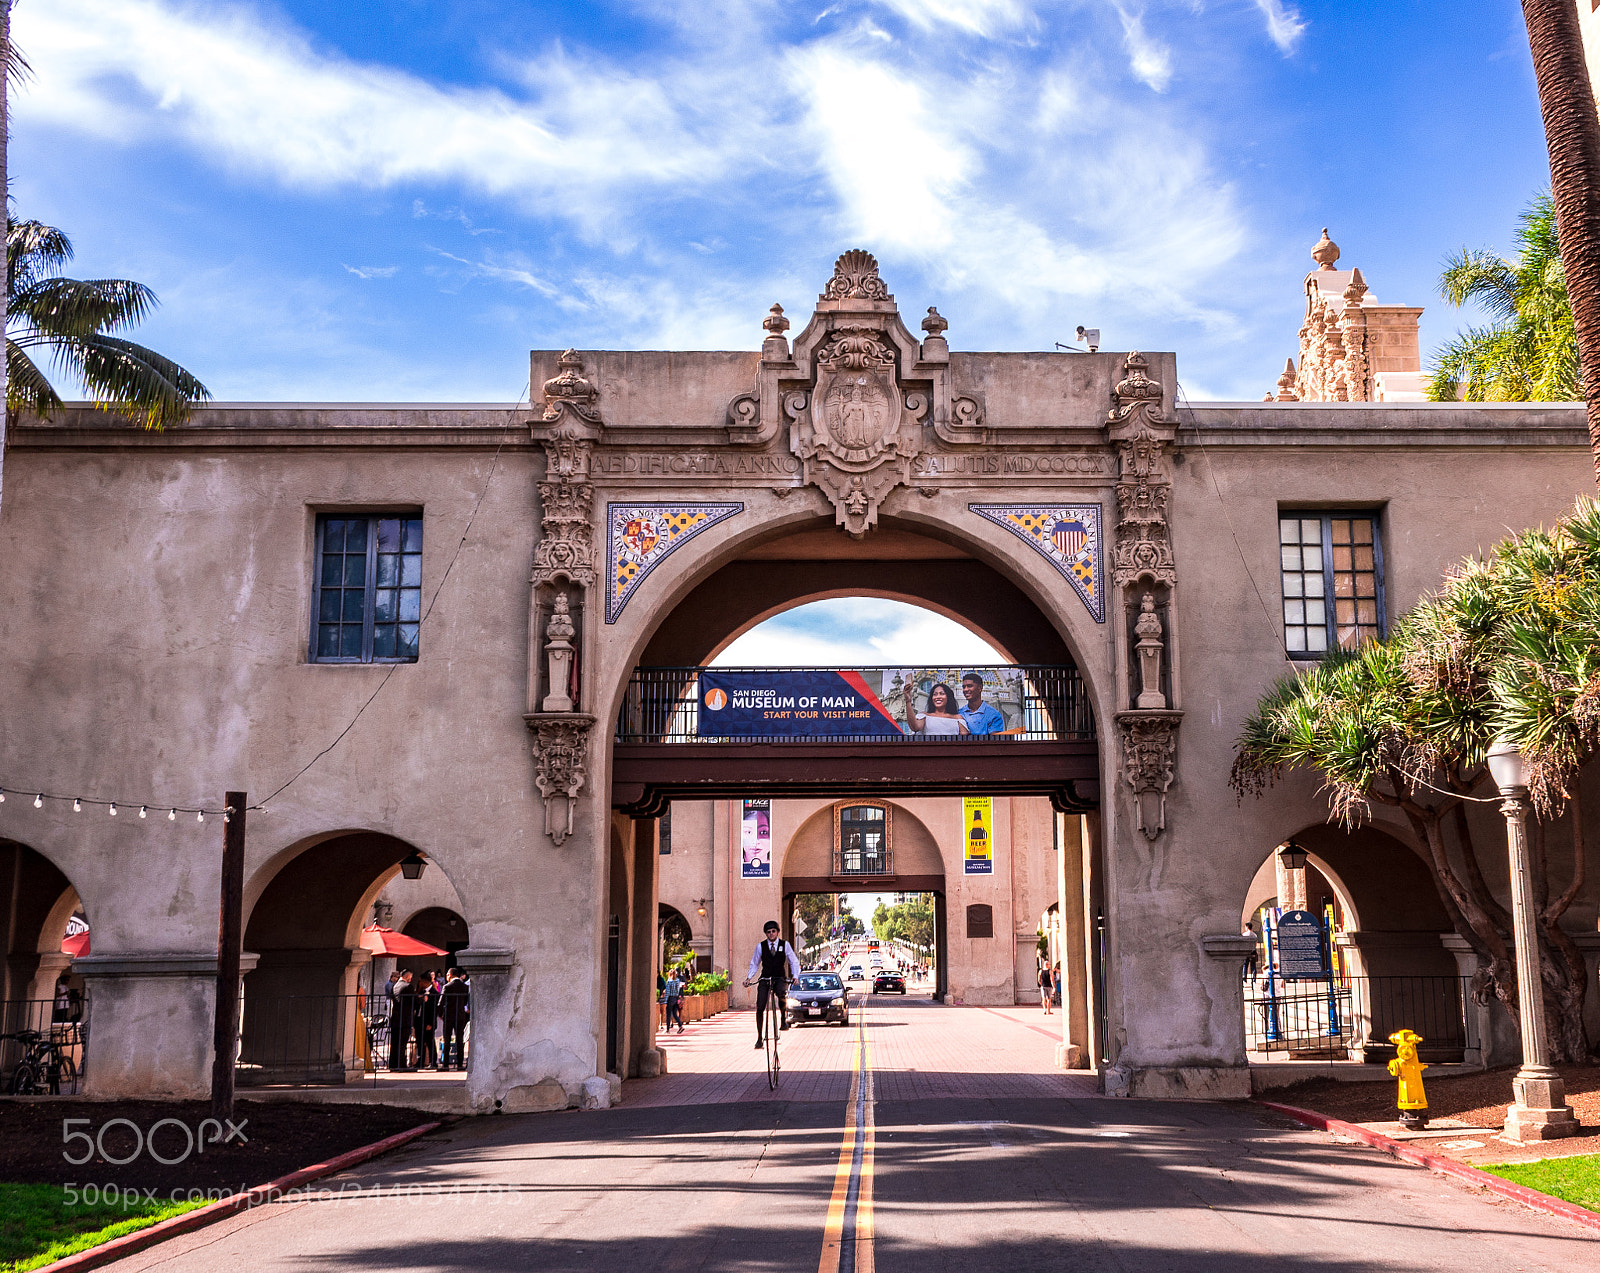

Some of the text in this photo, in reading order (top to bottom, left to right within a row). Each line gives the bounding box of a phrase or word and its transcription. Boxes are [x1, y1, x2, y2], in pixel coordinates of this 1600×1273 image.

[592, 455, 800, 474] AEDIFICATA ANNO
[914, 455, 1119, 474] SALUTIS MDCCCCXV
[616, 512, 635, 532] ORBIS
[638, 509, 655, 520] NON
[732, 696, 855, 709] MUSEUM OF MAN
[763, 710, 871, 719] START YOUR VISIT HERE
